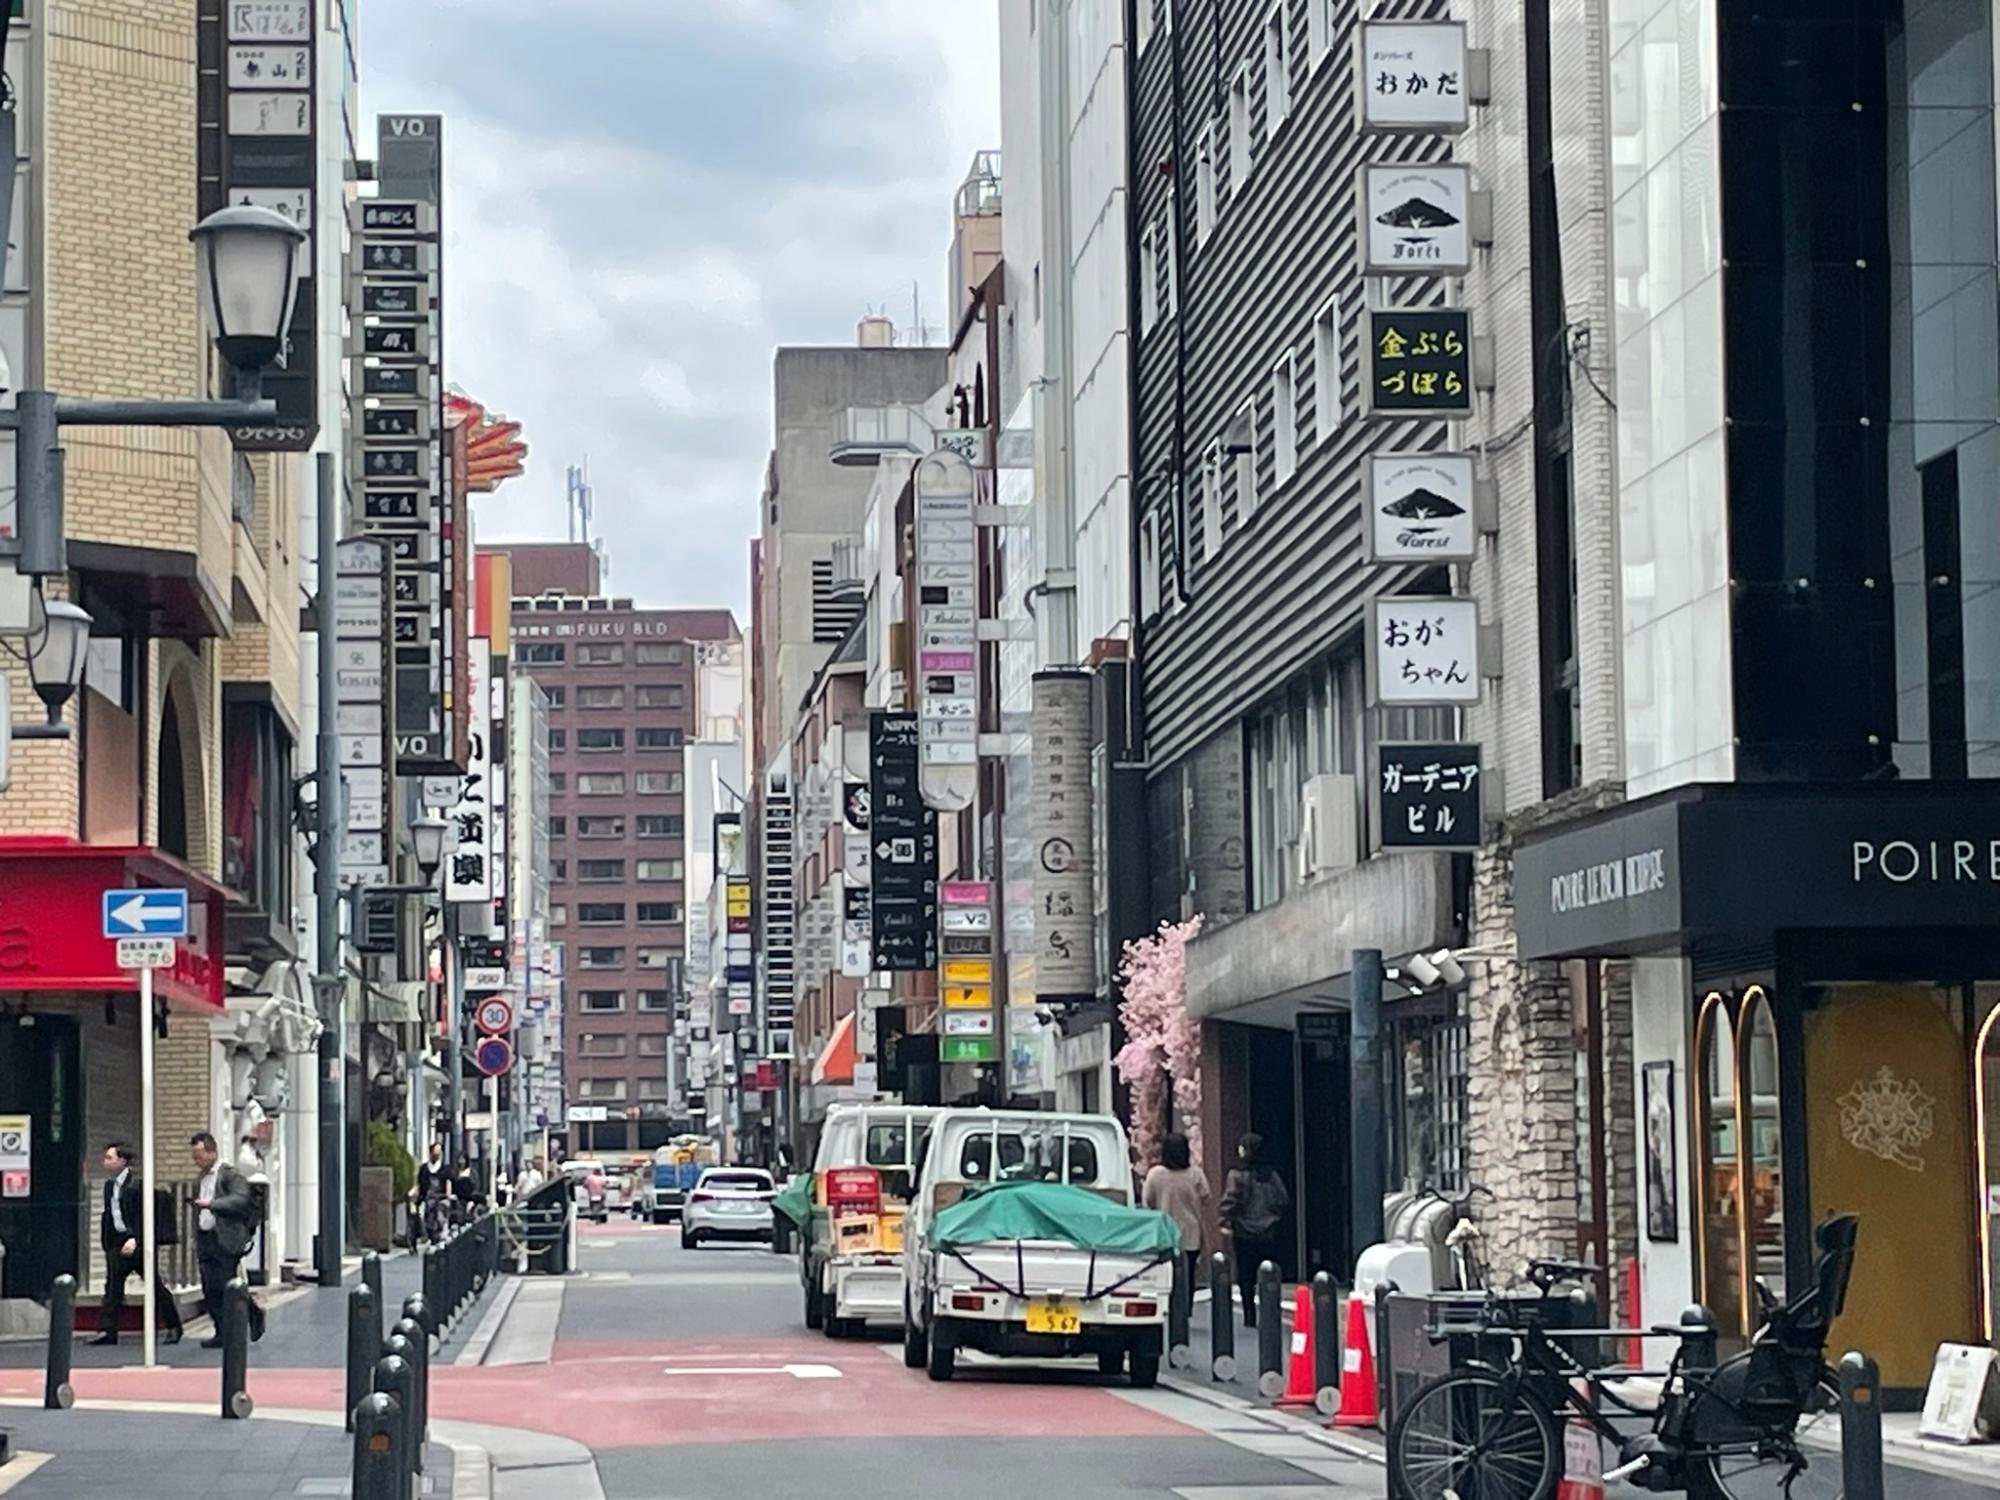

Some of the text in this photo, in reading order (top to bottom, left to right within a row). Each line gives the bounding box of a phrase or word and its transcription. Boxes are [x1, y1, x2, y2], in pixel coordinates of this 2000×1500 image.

[1376, 71, 1458, 95] おかだ
[390, 118, 425, 136] VO
[1384, 617, 1445, 648] おが
[1401, 657, 1470, 685] ちゃん
[1382, 762, 1479, 794] ガーデニア
[1408, 804, 1456, 834] ビル
[121, 952, 172, 965] ここから
[486, 1008, 505, 1024] 30
